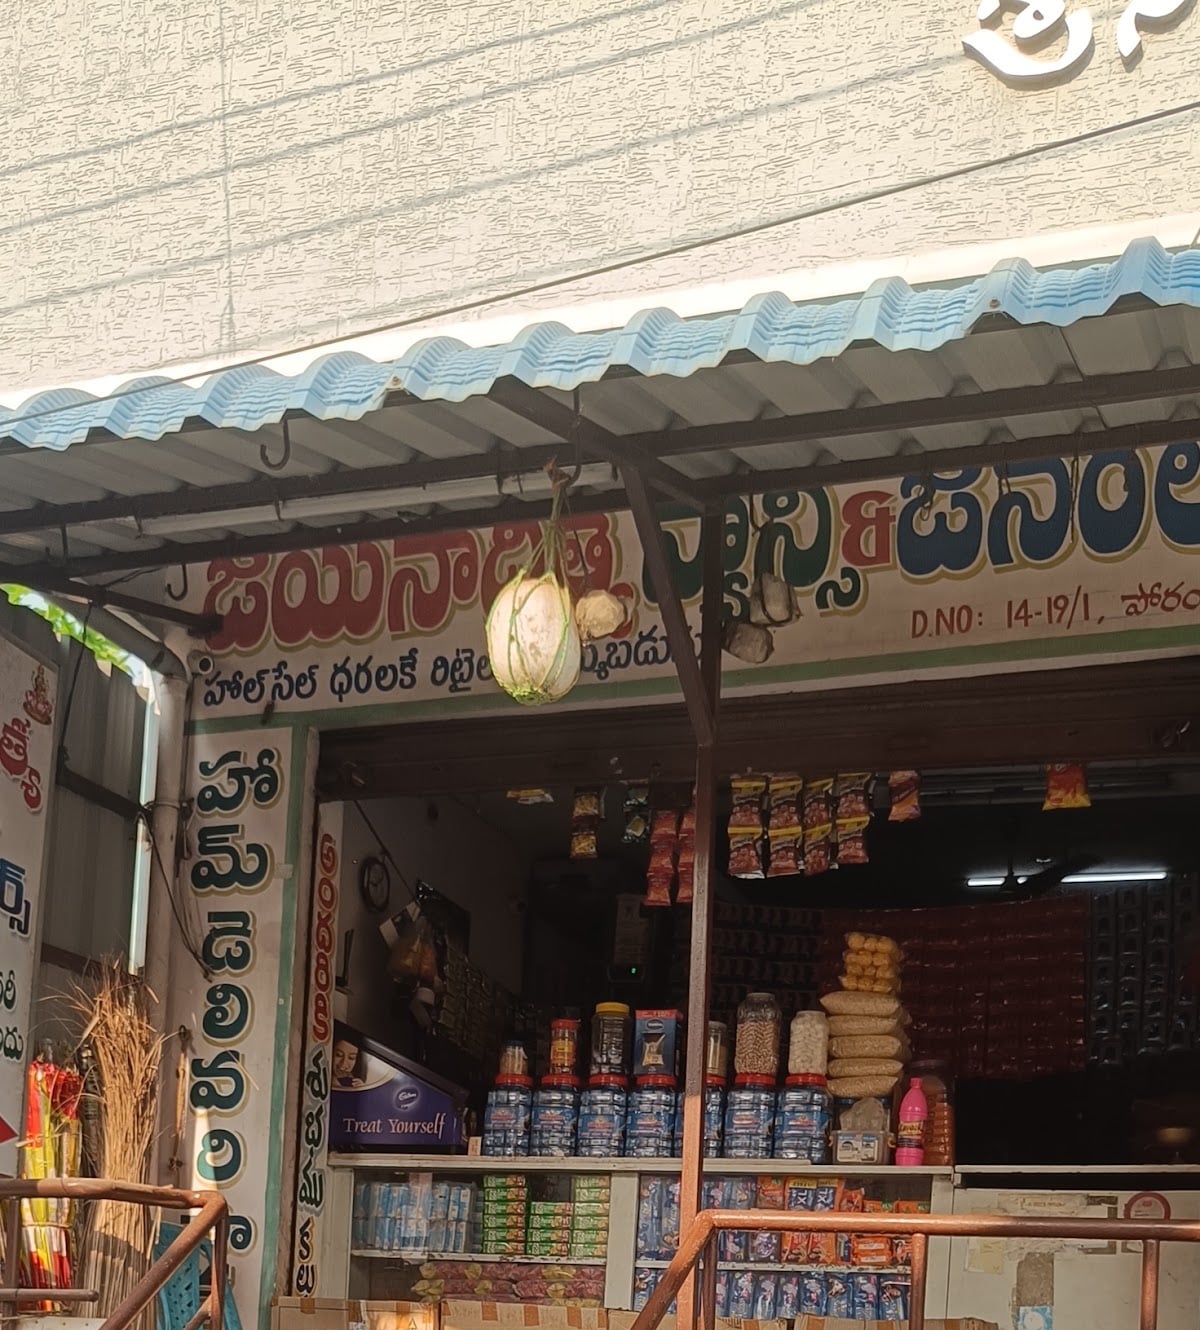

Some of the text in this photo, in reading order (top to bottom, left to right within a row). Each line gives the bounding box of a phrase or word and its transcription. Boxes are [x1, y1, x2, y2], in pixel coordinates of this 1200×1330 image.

[911, 604, 983, 639] D.NO:
[1006, 585, 1106, 629] 14-19/1,
[330, 647, 418, 702] ధరలకే
[343, 1113, 447, 1140] Treat Yourself
